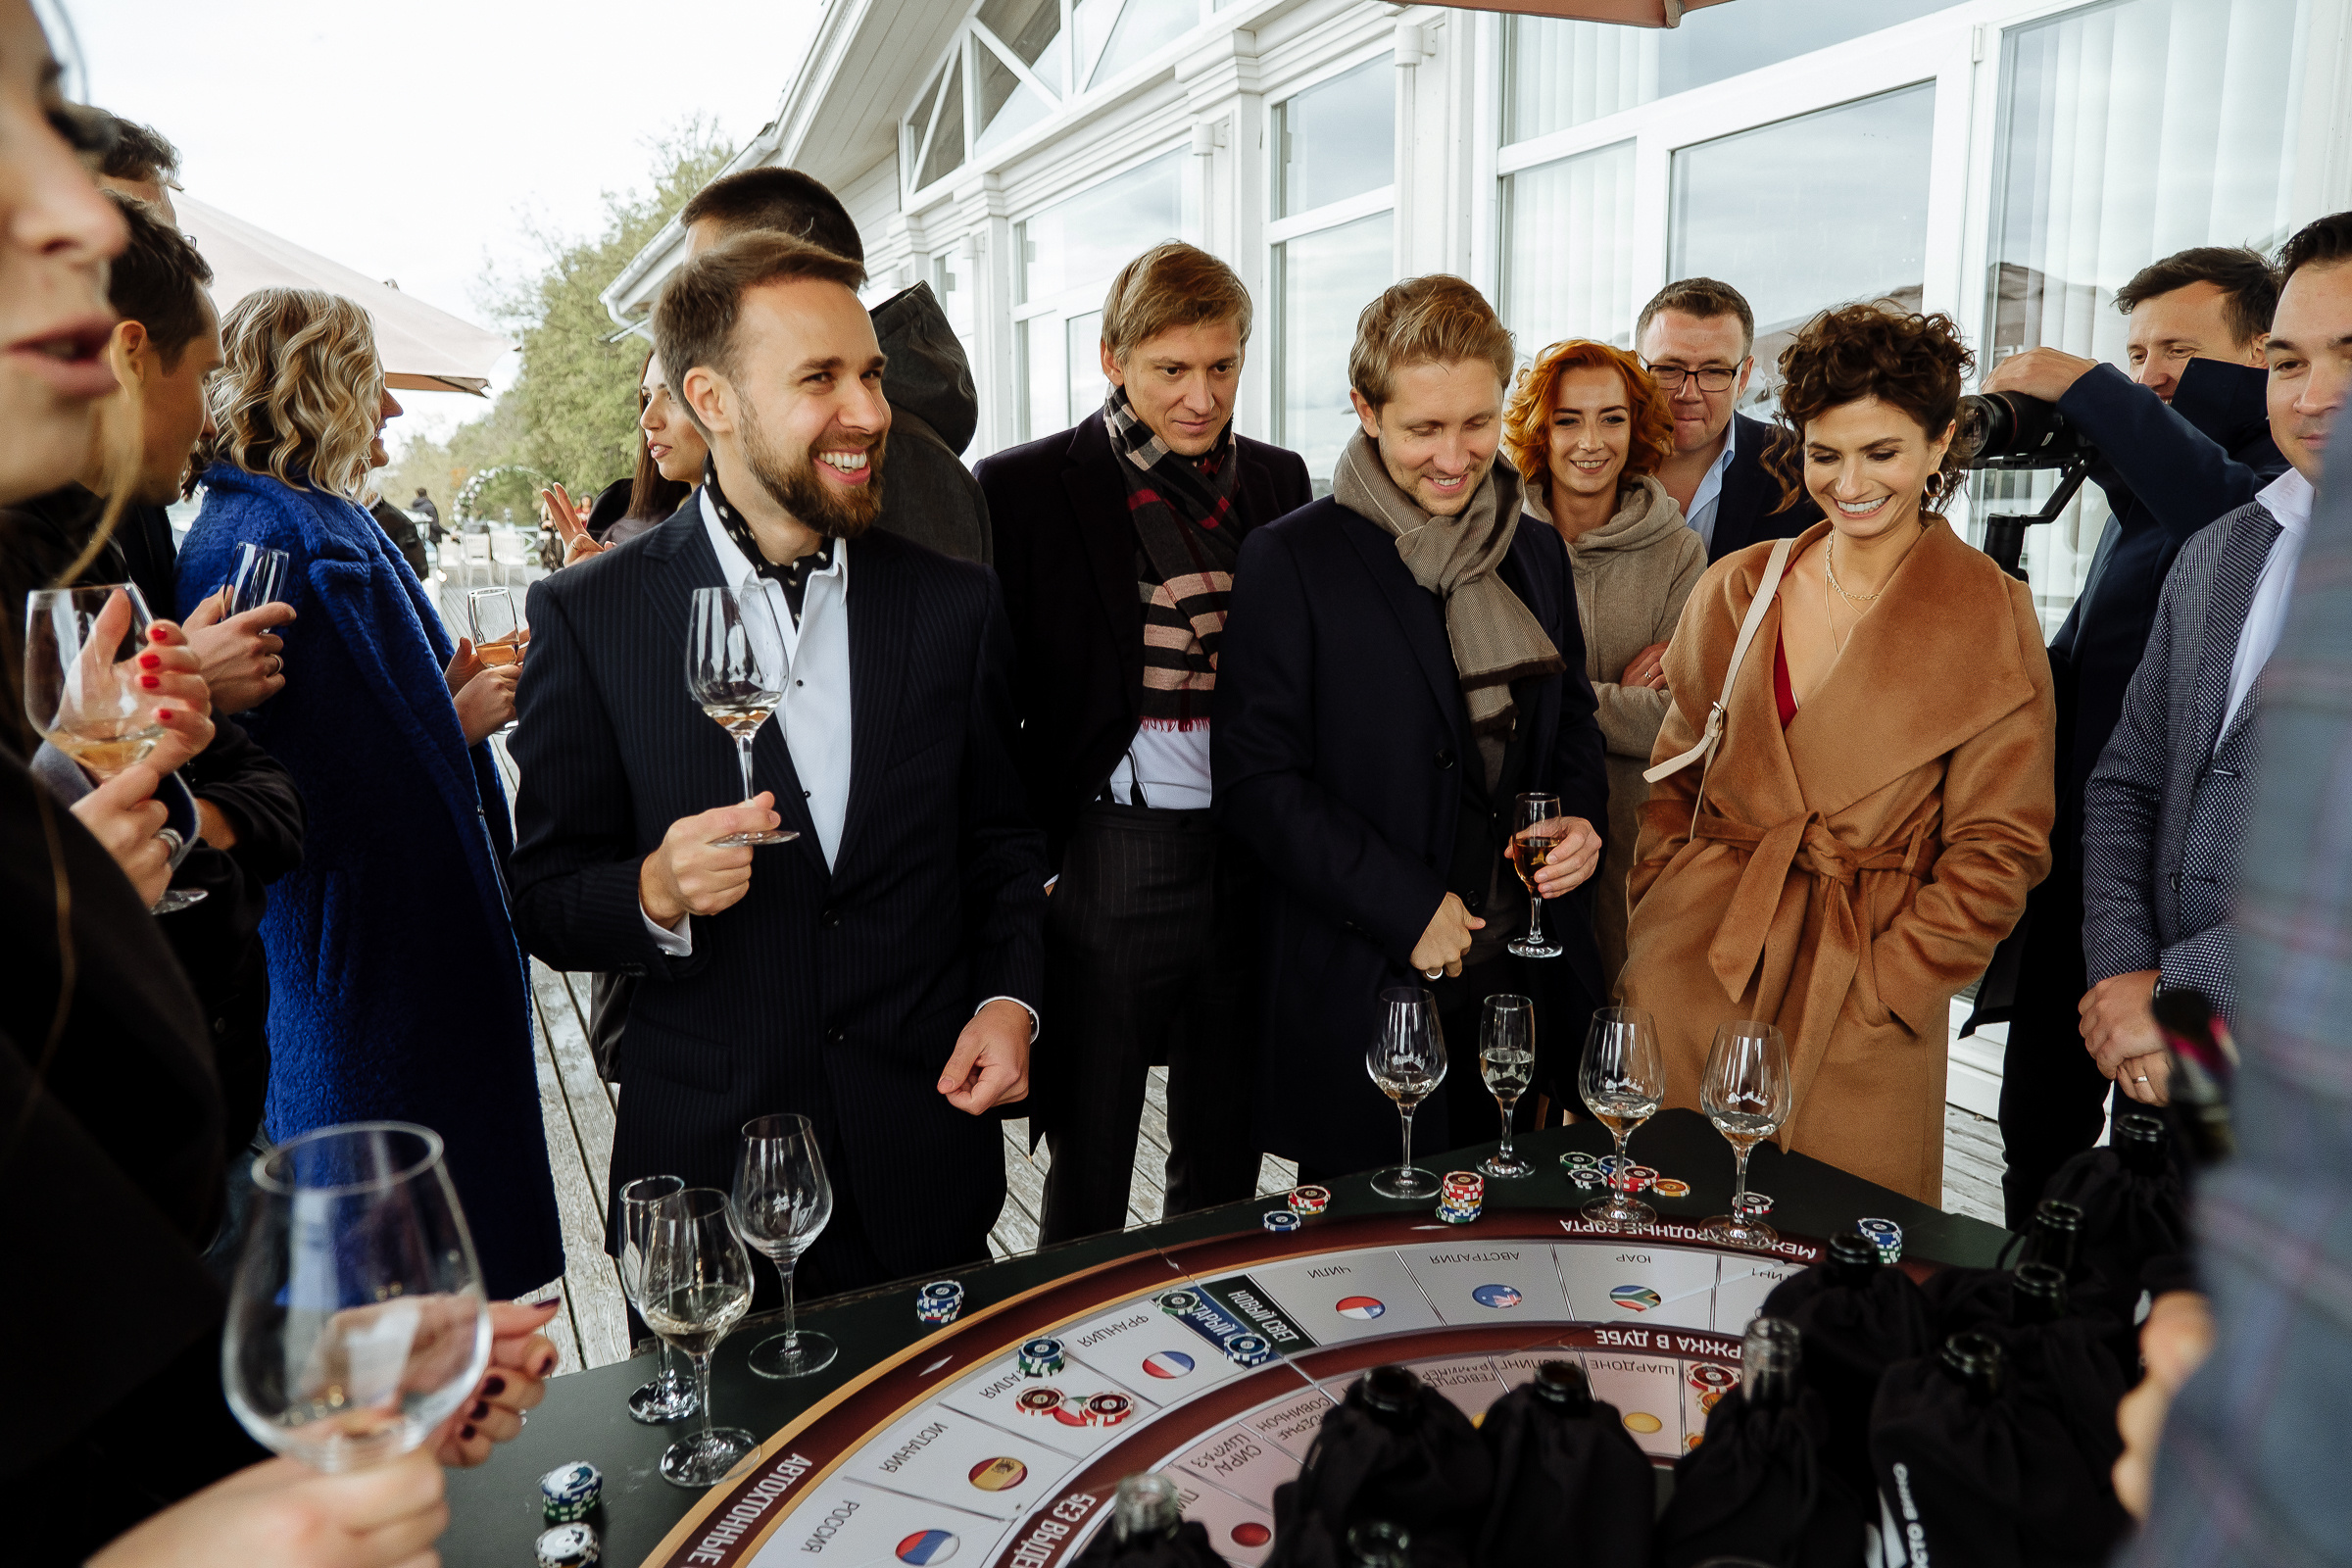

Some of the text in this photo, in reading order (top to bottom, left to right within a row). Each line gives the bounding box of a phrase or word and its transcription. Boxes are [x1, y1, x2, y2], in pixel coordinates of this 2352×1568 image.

[1559, 1219, 1620, 1234] СОРТА
[1307, 1264, 1351, 1279] ЧИЛИ
[1429, 1251, 1520, 1264] АВСТРАЛИЯ
[1616, 1253, 1651, 1264] ЮАР
[1077, 1314, 1150, 1348] ФРАНЦИЯ
[1192, 1301, 1238, 1337] ТАРЫЙ
[1228, 1290, 1299, 1343] НОВЫЙ СВЕТ
[1594, 1329, 1741, 1360] РЖКА В ДУБЕ
[1590, 1359, 1675, 1376] ШАРДОНЕ
[1255, 1396, 1331, 1432] СОВИНЬОН
[878, 1422, 949, 1473] ИСПАНИЯ
[687, 1452, 812, 1566] АВТОХТОННЫЕ
[801, 1499, 860, 1553] РОССИЯ
[1009, 1494, 1097, 1568] БЕЗ ВЫДЕ
